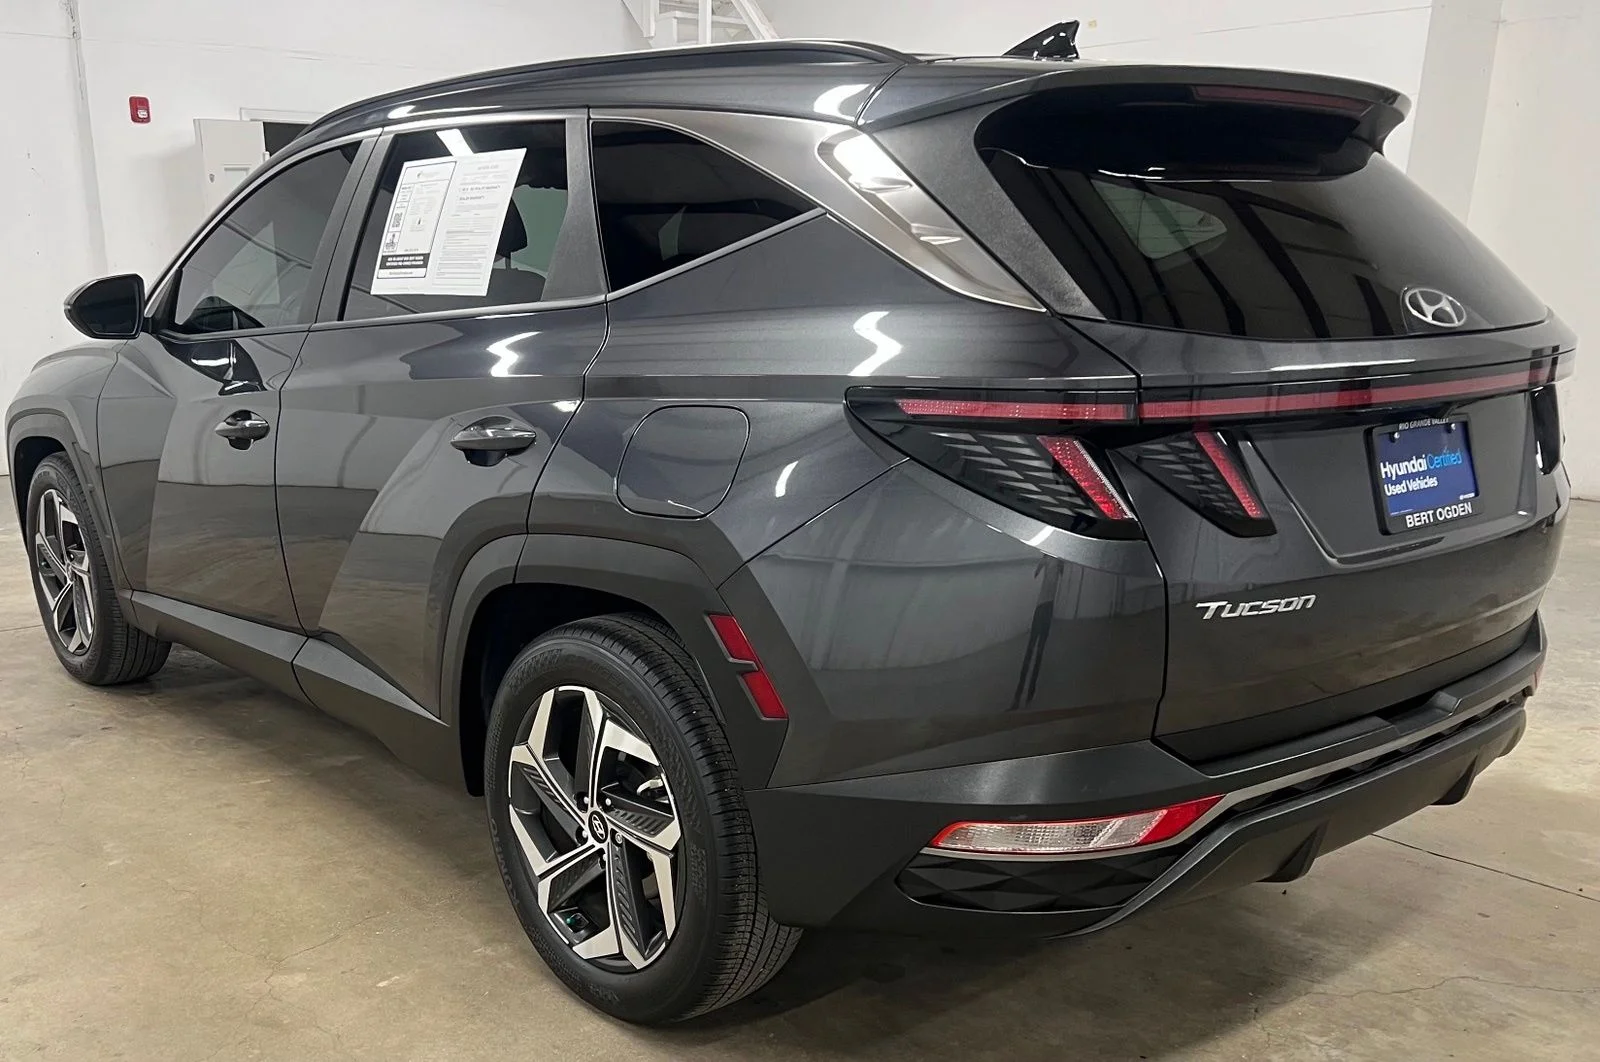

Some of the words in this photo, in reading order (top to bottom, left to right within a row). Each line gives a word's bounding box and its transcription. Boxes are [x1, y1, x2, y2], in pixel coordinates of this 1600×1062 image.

[1380, 454, 1428, 480] Hyundai
[1427, 448, 1462, 469] Certified
[1384, 479, 1407, 496] Used
[1406, 475, 1439, 492] Vehicles
[1405, 510, 1434, 528] BERT
[1436, 501, 1473, 521] OGDEN
